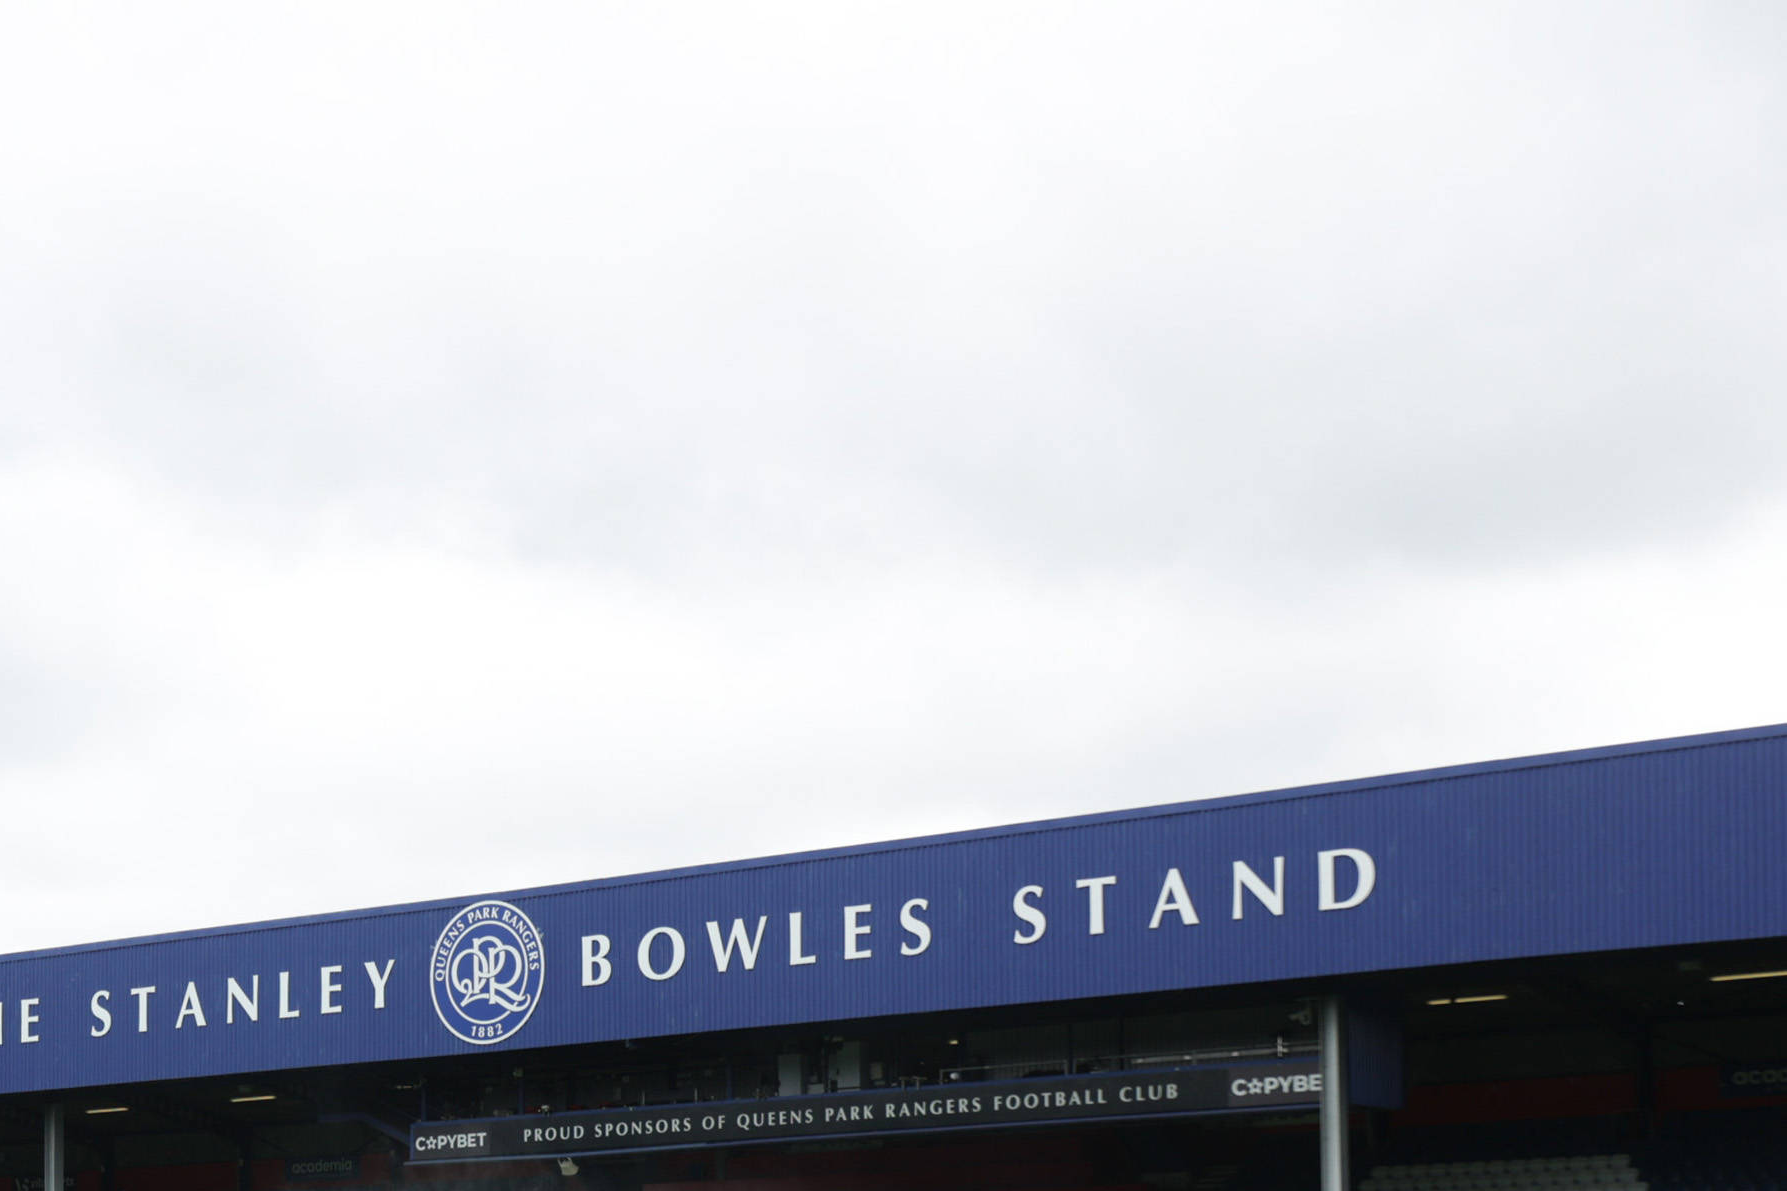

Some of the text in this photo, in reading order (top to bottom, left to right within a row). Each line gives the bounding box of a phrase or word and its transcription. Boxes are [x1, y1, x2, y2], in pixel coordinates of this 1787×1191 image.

[435, 906, 540, 982] QUEENS PARK RANGERS
[580, 847, 1378, 988] BOWLES STAND
[90, 958, 396, 1038] STANLEY
[470, 1023, 503, 1038] 1882
[523, 1083, 1179, 1142] PROUD SPONSORS OF QUEENS PARK RANGERS FOOTBALL CLUB
[1231, 1073, 1324, 1096] COPYBE
